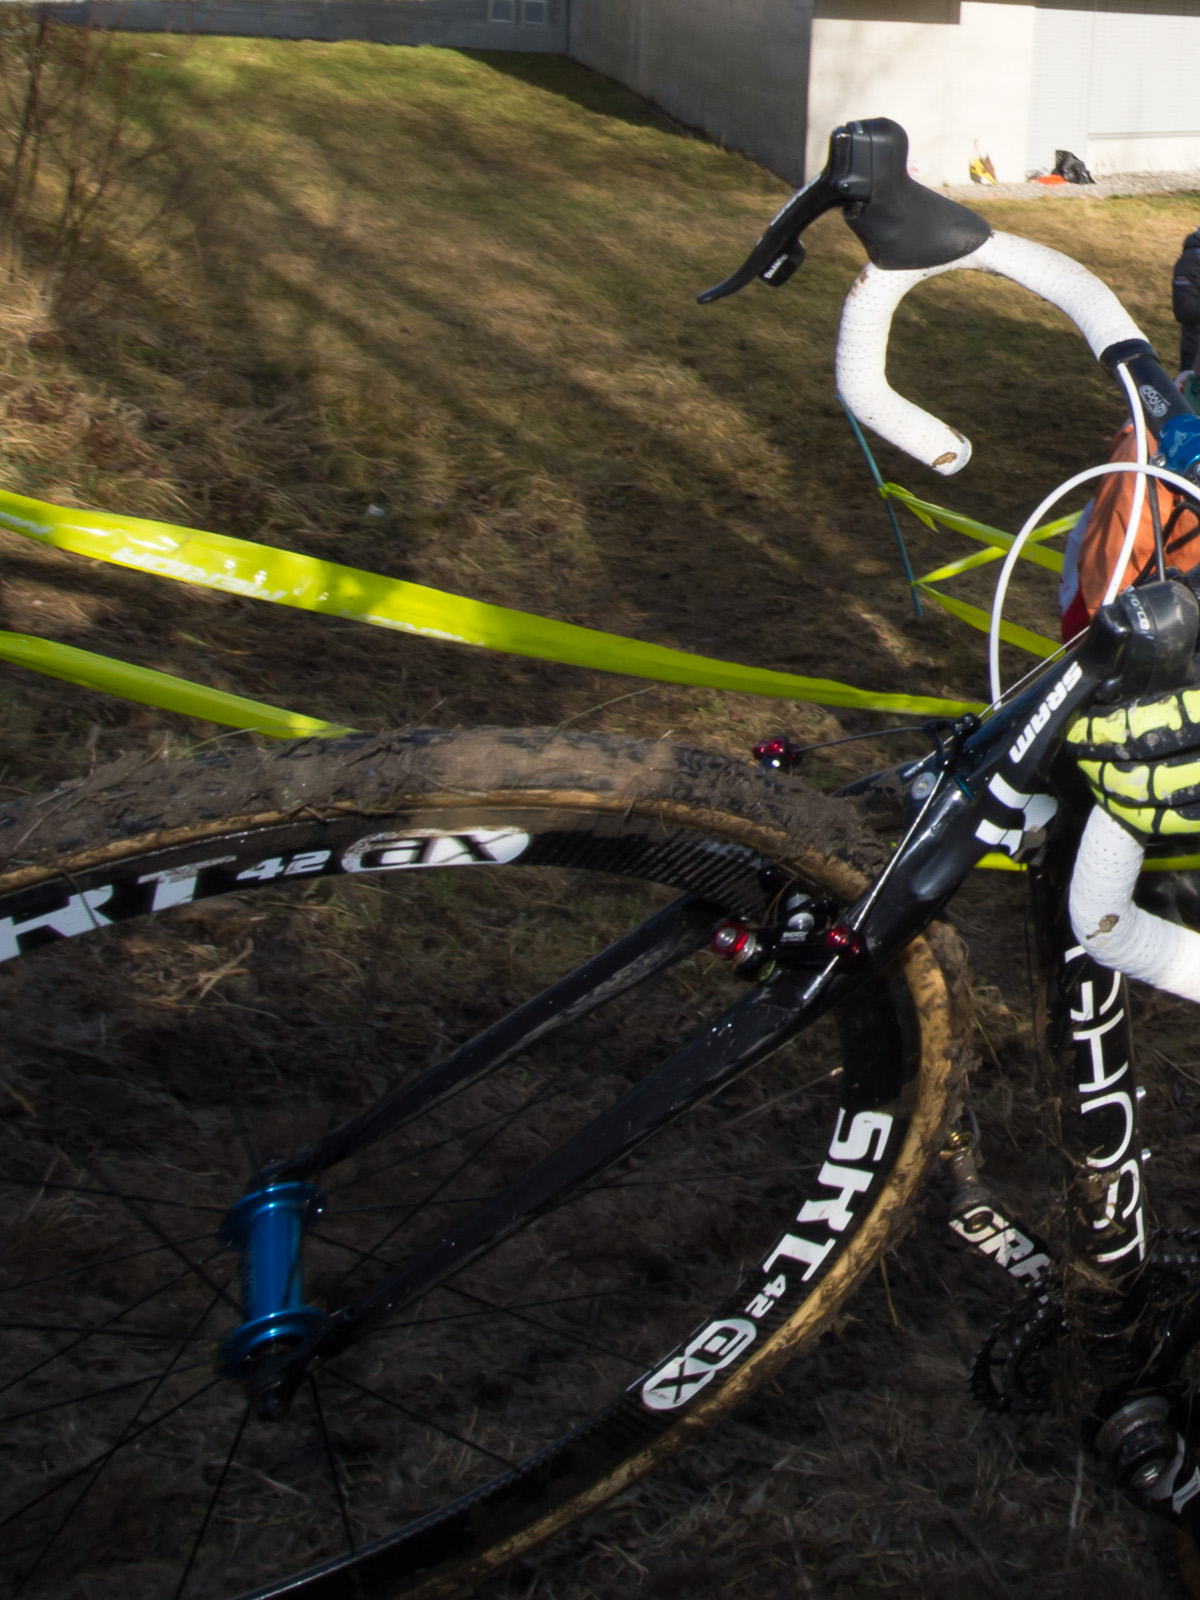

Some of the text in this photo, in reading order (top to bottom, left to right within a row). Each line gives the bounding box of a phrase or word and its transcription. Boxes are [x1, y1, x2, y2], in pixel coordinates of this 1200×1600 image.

[1009, 660, 1083, 764] SRAM
[235, 849, 332, 882] 42
[744, 1273, 787, 1319] 42
